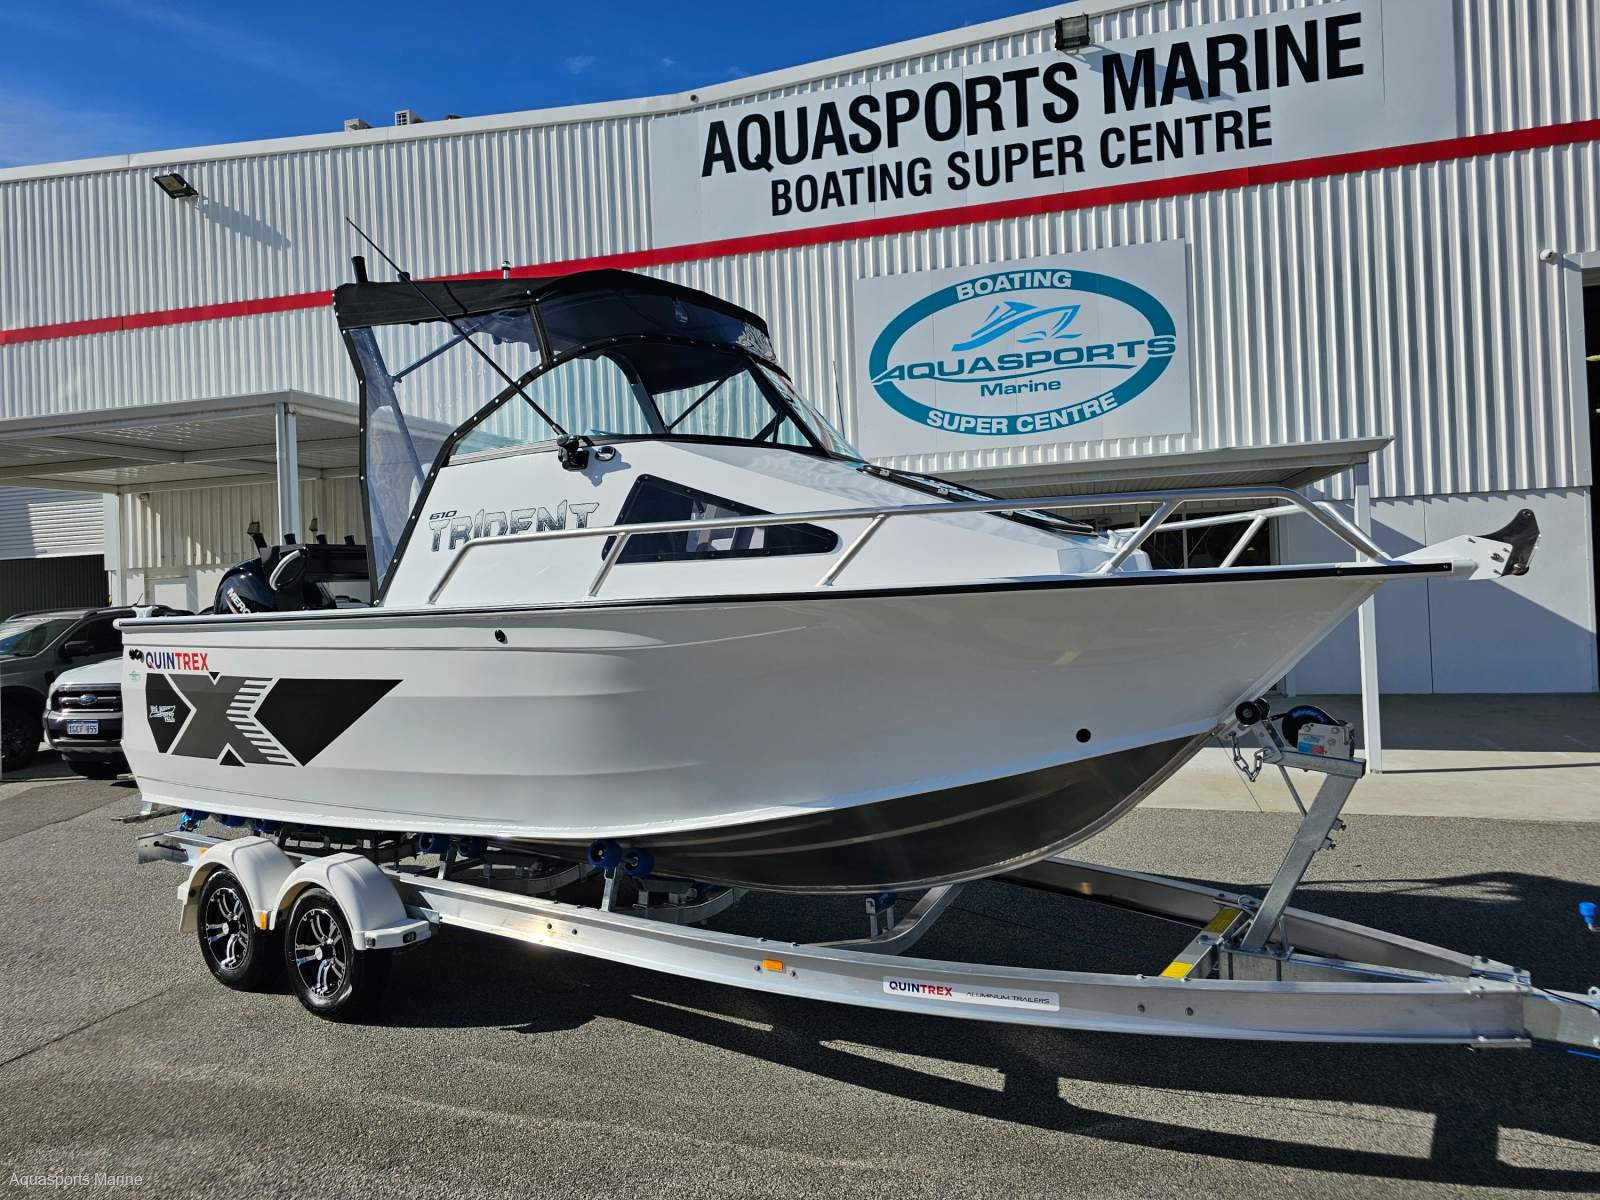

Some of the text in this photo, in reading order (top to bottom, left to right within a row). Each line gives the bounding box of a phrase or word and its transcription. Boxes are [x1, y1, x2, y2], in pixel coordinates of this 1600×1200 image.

[701, 13, 1364, 178] AQUASPORTS MARINE
[771, 105, 1273, 217] BOATING SUPER CENTRE
[956, 271, 1072, 301] BOATING
[872, 336, 1176, 383] AQUASPORTS
[980, 379, 1061, 397] Marine
[926, 392, 1118, 434] SUPER CENTRE
[428, 499, 599, 551] TRIDENT
[429, 510, 457, 520] 610
[145, 651, 209, 671] QUINTREX
[889, 980, 953, 997] QUINTREX
[1013, 994, 1051, 1005] TRAILERS
